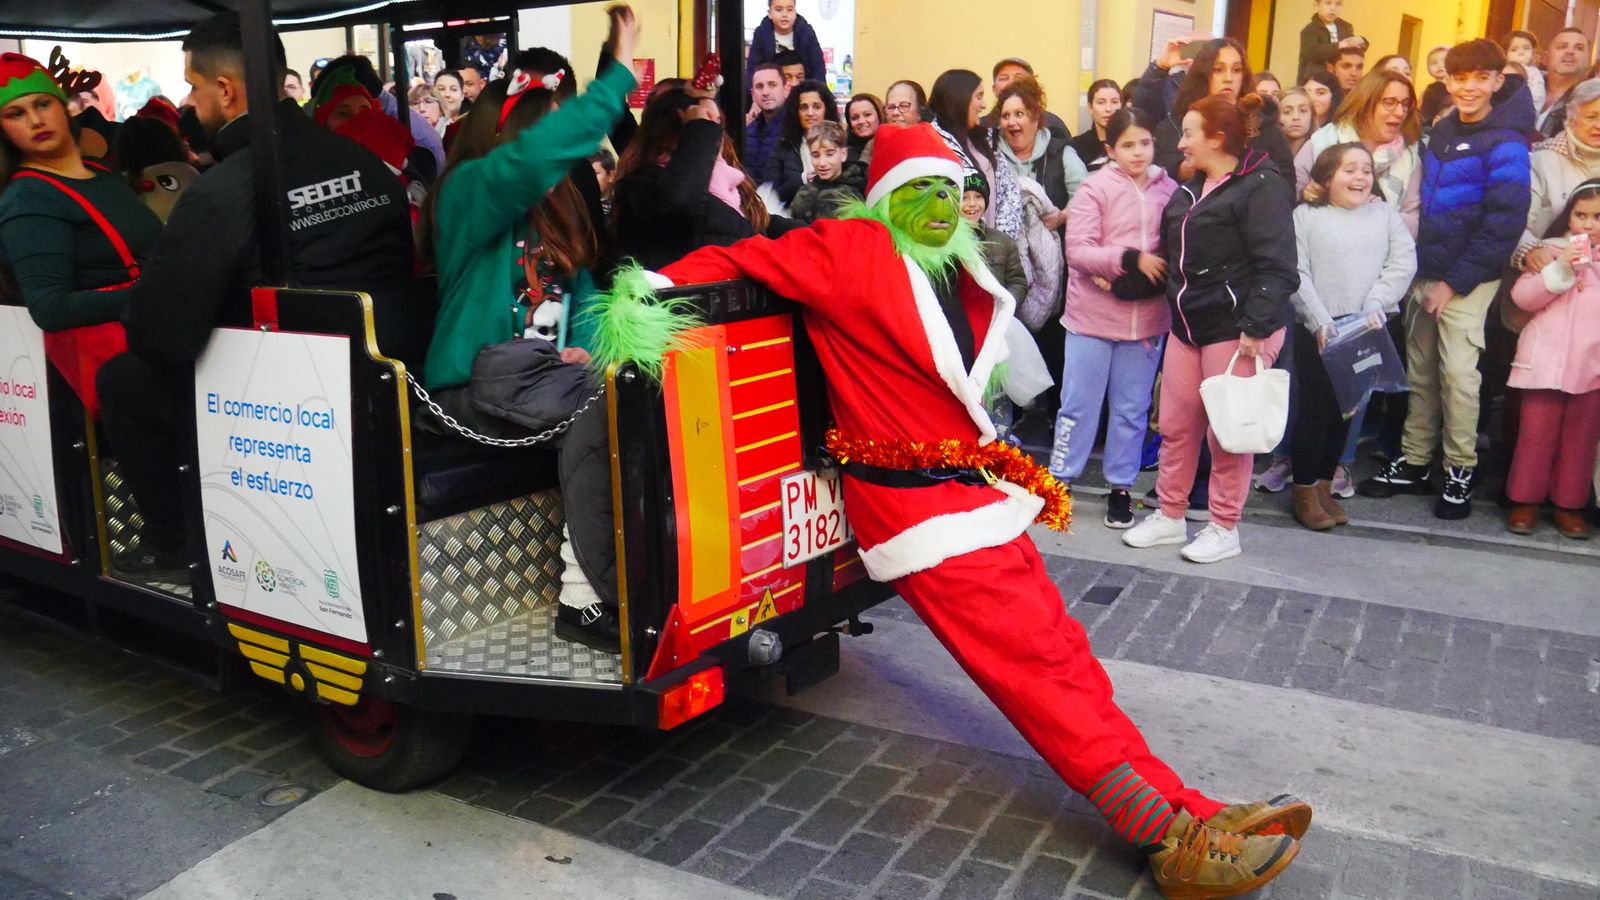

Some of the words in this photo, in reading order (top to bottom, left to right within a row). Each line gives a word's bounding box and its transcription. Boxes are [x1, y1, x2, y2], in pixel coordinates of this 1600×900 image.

[287, 170, 362, 210] SELECT
[292, 191, 370, 217] CONTROL
[12, 379, 37, 400] local
[207, 392, 220, 414] El
[223, 401, 293, 424] comercio
[297, 403, 335, 430] local
[229, 435, 312, 464] representa
[231, 466, 243, 488] el
[246, 471, 314, 501] esfuerzo
[786, 474, 818, 520] PM
[218, 565, 247, 580] ACOSAFE
[329, 608, 353, 620] Fernando
